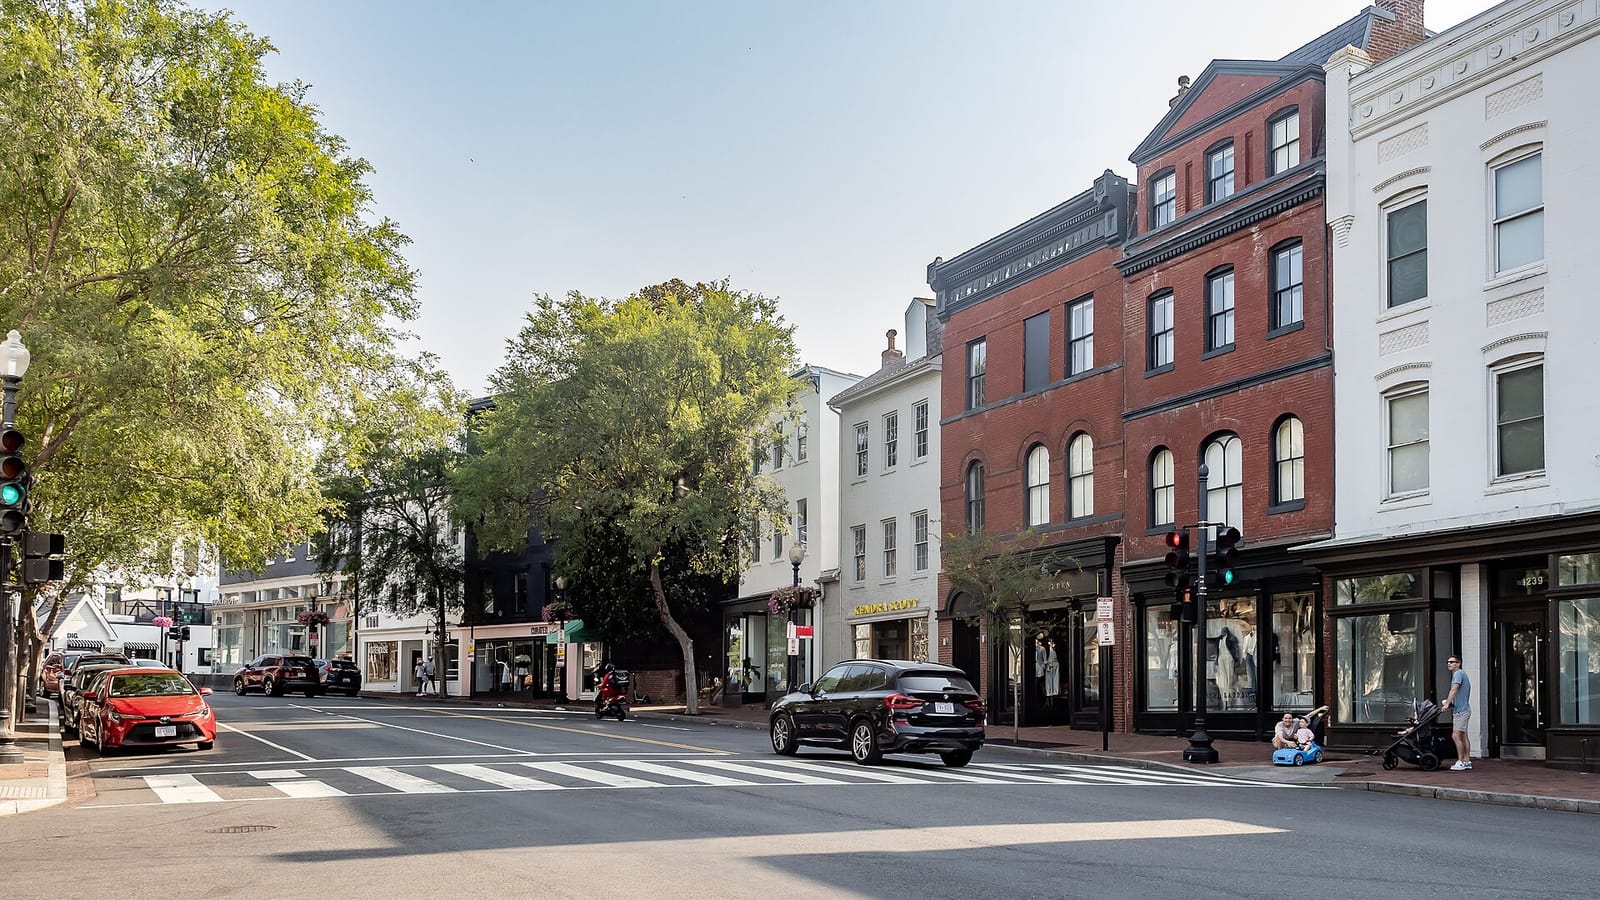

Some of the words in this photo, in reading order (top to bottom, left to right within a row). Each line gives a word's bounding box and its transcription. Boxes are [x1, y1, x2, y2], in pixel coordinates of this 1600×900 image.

[1522, 576, 1543, 586] 1239
[853, 603, 888, 616] KENDRA
[889, 598, 918, 611] SCOTT
